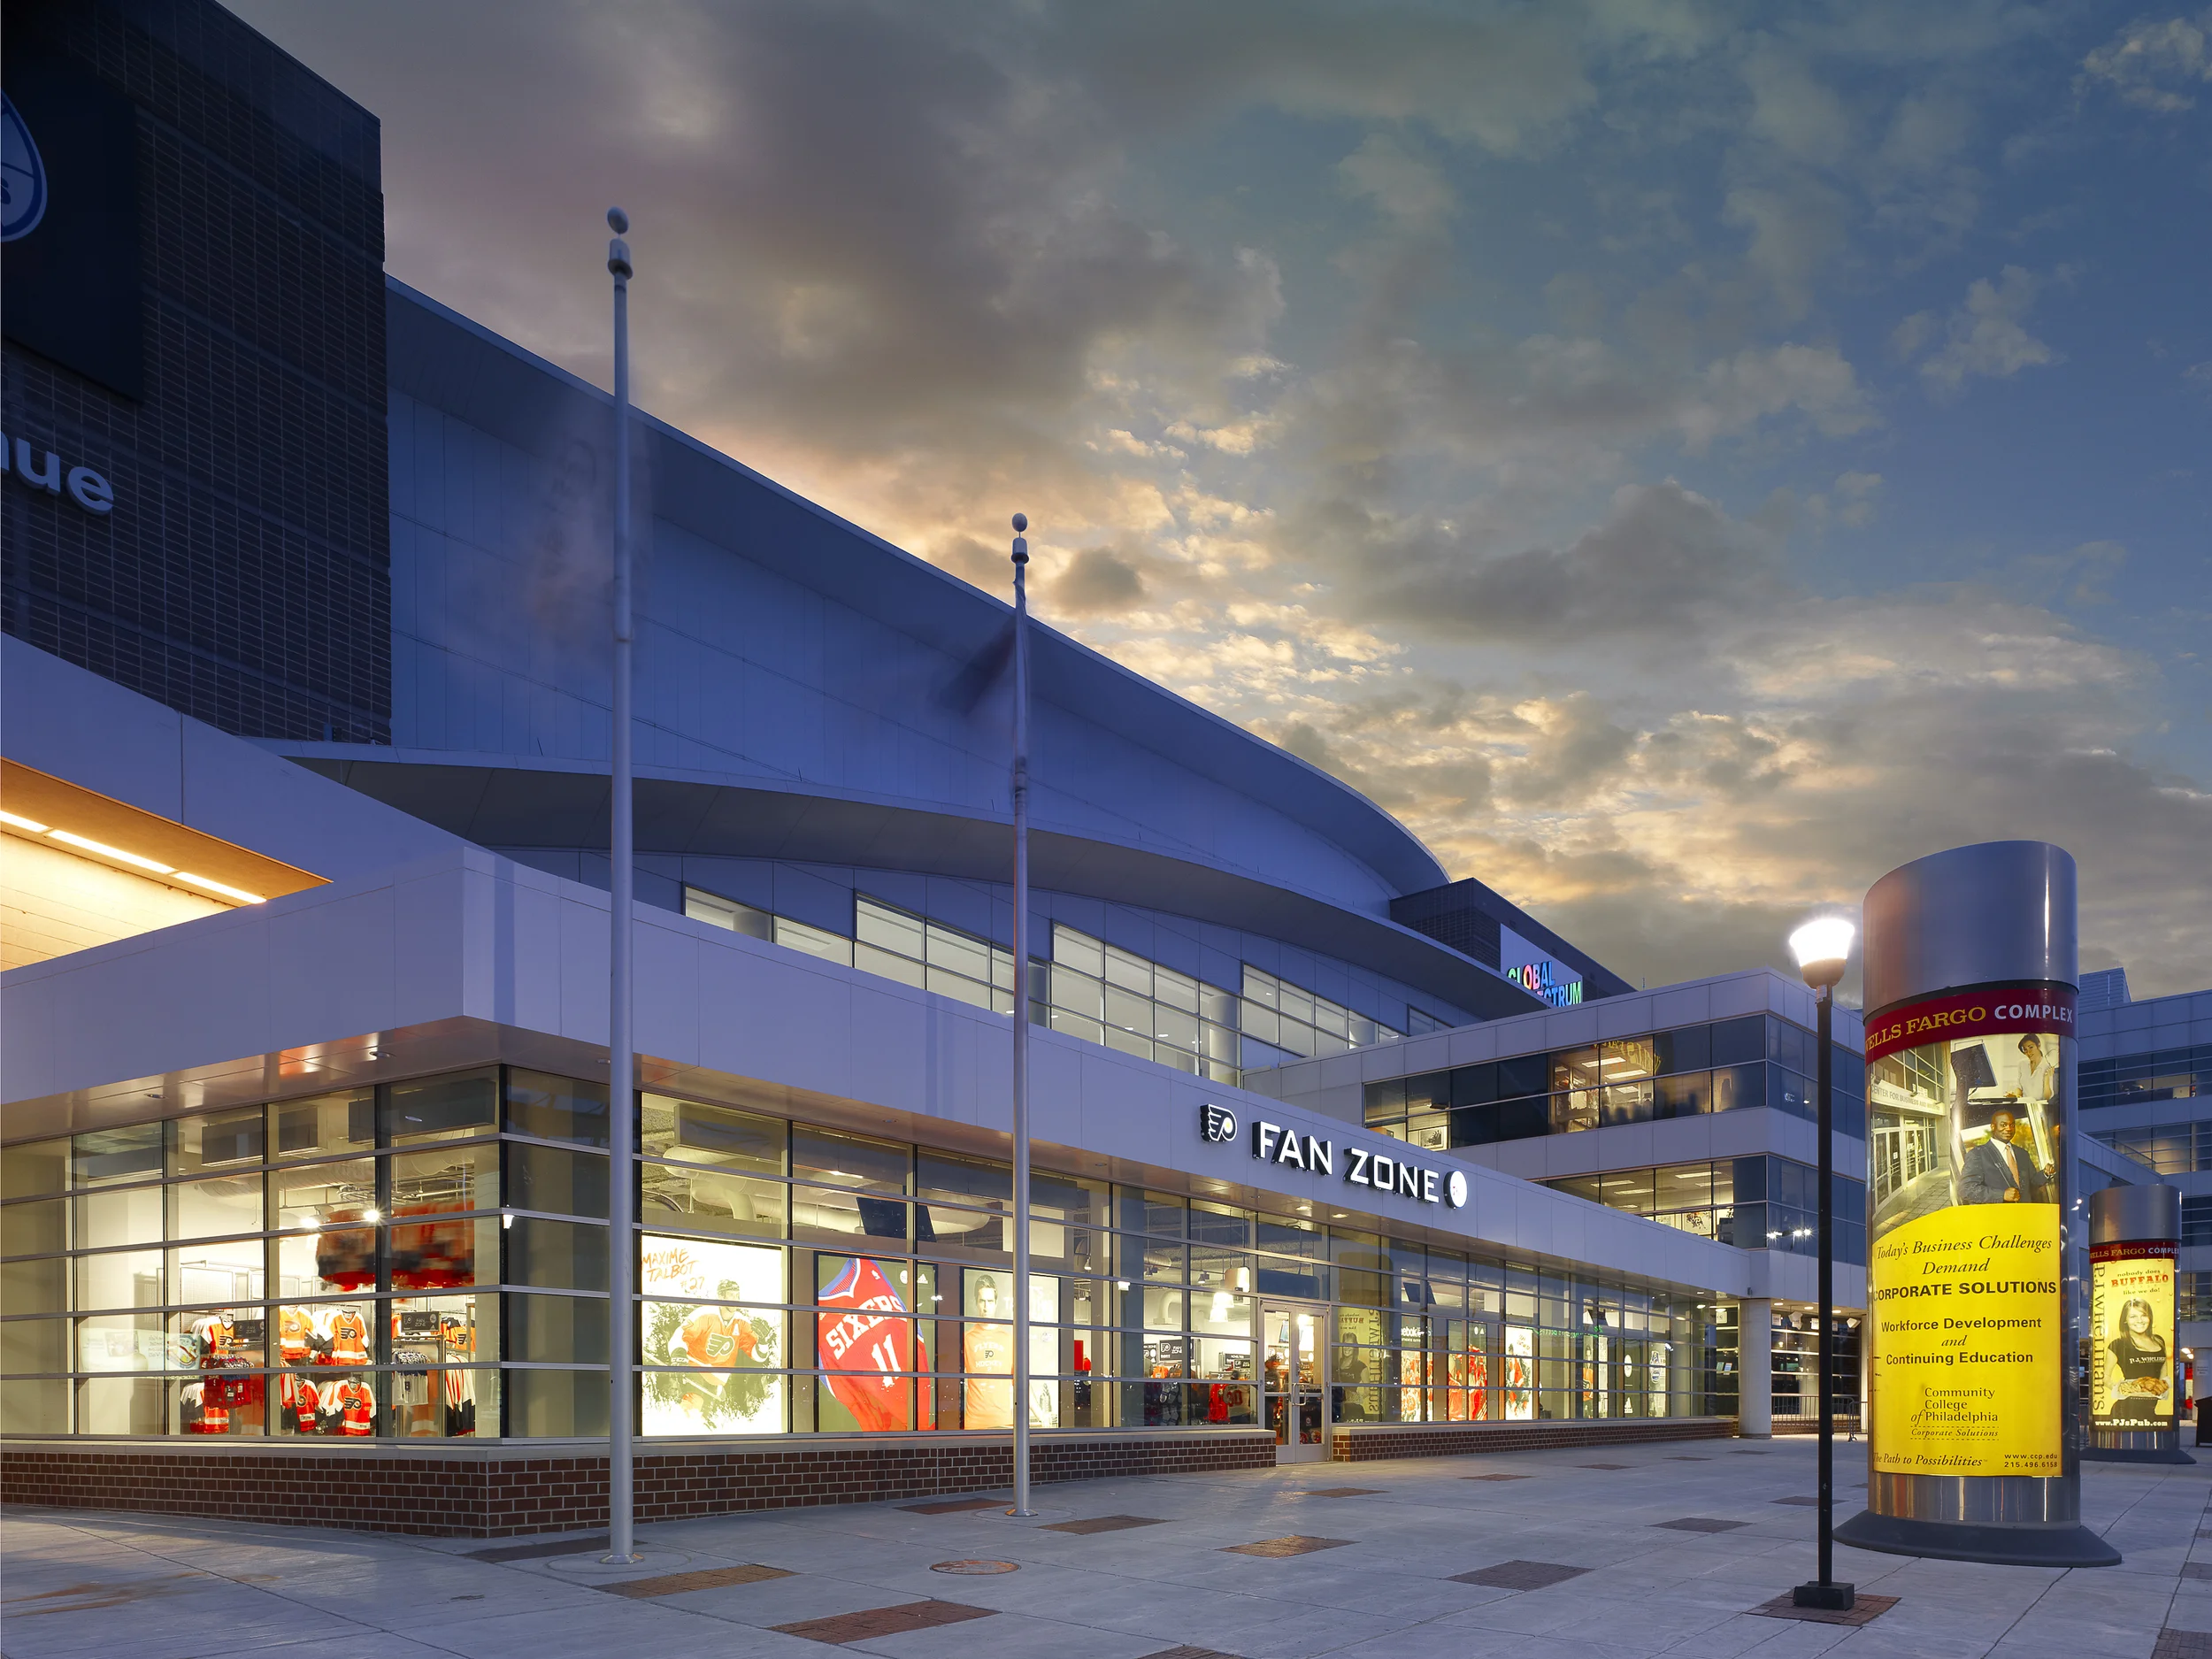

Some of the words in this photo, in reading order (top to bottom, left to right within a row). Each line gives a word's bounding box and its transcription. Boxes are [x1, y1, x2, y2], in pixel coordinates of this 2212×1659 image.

[0, 431, 113, 511] ue
[1906, 1007, 1986, 1035] FARGO
[1994, 1004, 2072, 1024] COMPLEX
[1256, 1121, 1333, 1175] FAN
[1347, 1147, 1440, 1203] ZONE
[1877, 1242, 1909, 1260] Today's
[1912, 1239, 1973, 1254] Business
[1978, 1235, 2053, 1253] Challenges
[2111, 1247, 2146, 1256] FARGO
[642, 1248, 689, 1268] MAXIME
[647, 1260, 699, 1282] TALBOT
[1923, 1258, 1990, 1275] Demand
[1959, 1281, 2057, 1294] SOLUTIONS
[2111, 1274, 2169, 1287] BUFFALO
[826, 1295, 907, 1360] SIXERS
[1881, 1319, 1939, 1332] Workforce
[1944, 1317, 2042, 1331] Development
[1941, 1335, 1967, 1347] and
[872, 1333, 902, 1387] 11
[1886, 1353, 1954, 1365] Continuing
[1959, 1351, 2033, 1363] Education
[1924, 1387, 1995, 1399] Community
[1924, 1399, 1968, 1410] College
[1910, 1409, 1926, 1426] of
[1925, 1411, 1998, 1425] Philadelphia
[1911, 1428, 1953, 1438] Corporate
[1955, 1428, 1999, 1438] Solutions
[1884, 1453, 1901, 1463] Path
[1903, 1455, 1912, 1464] to
